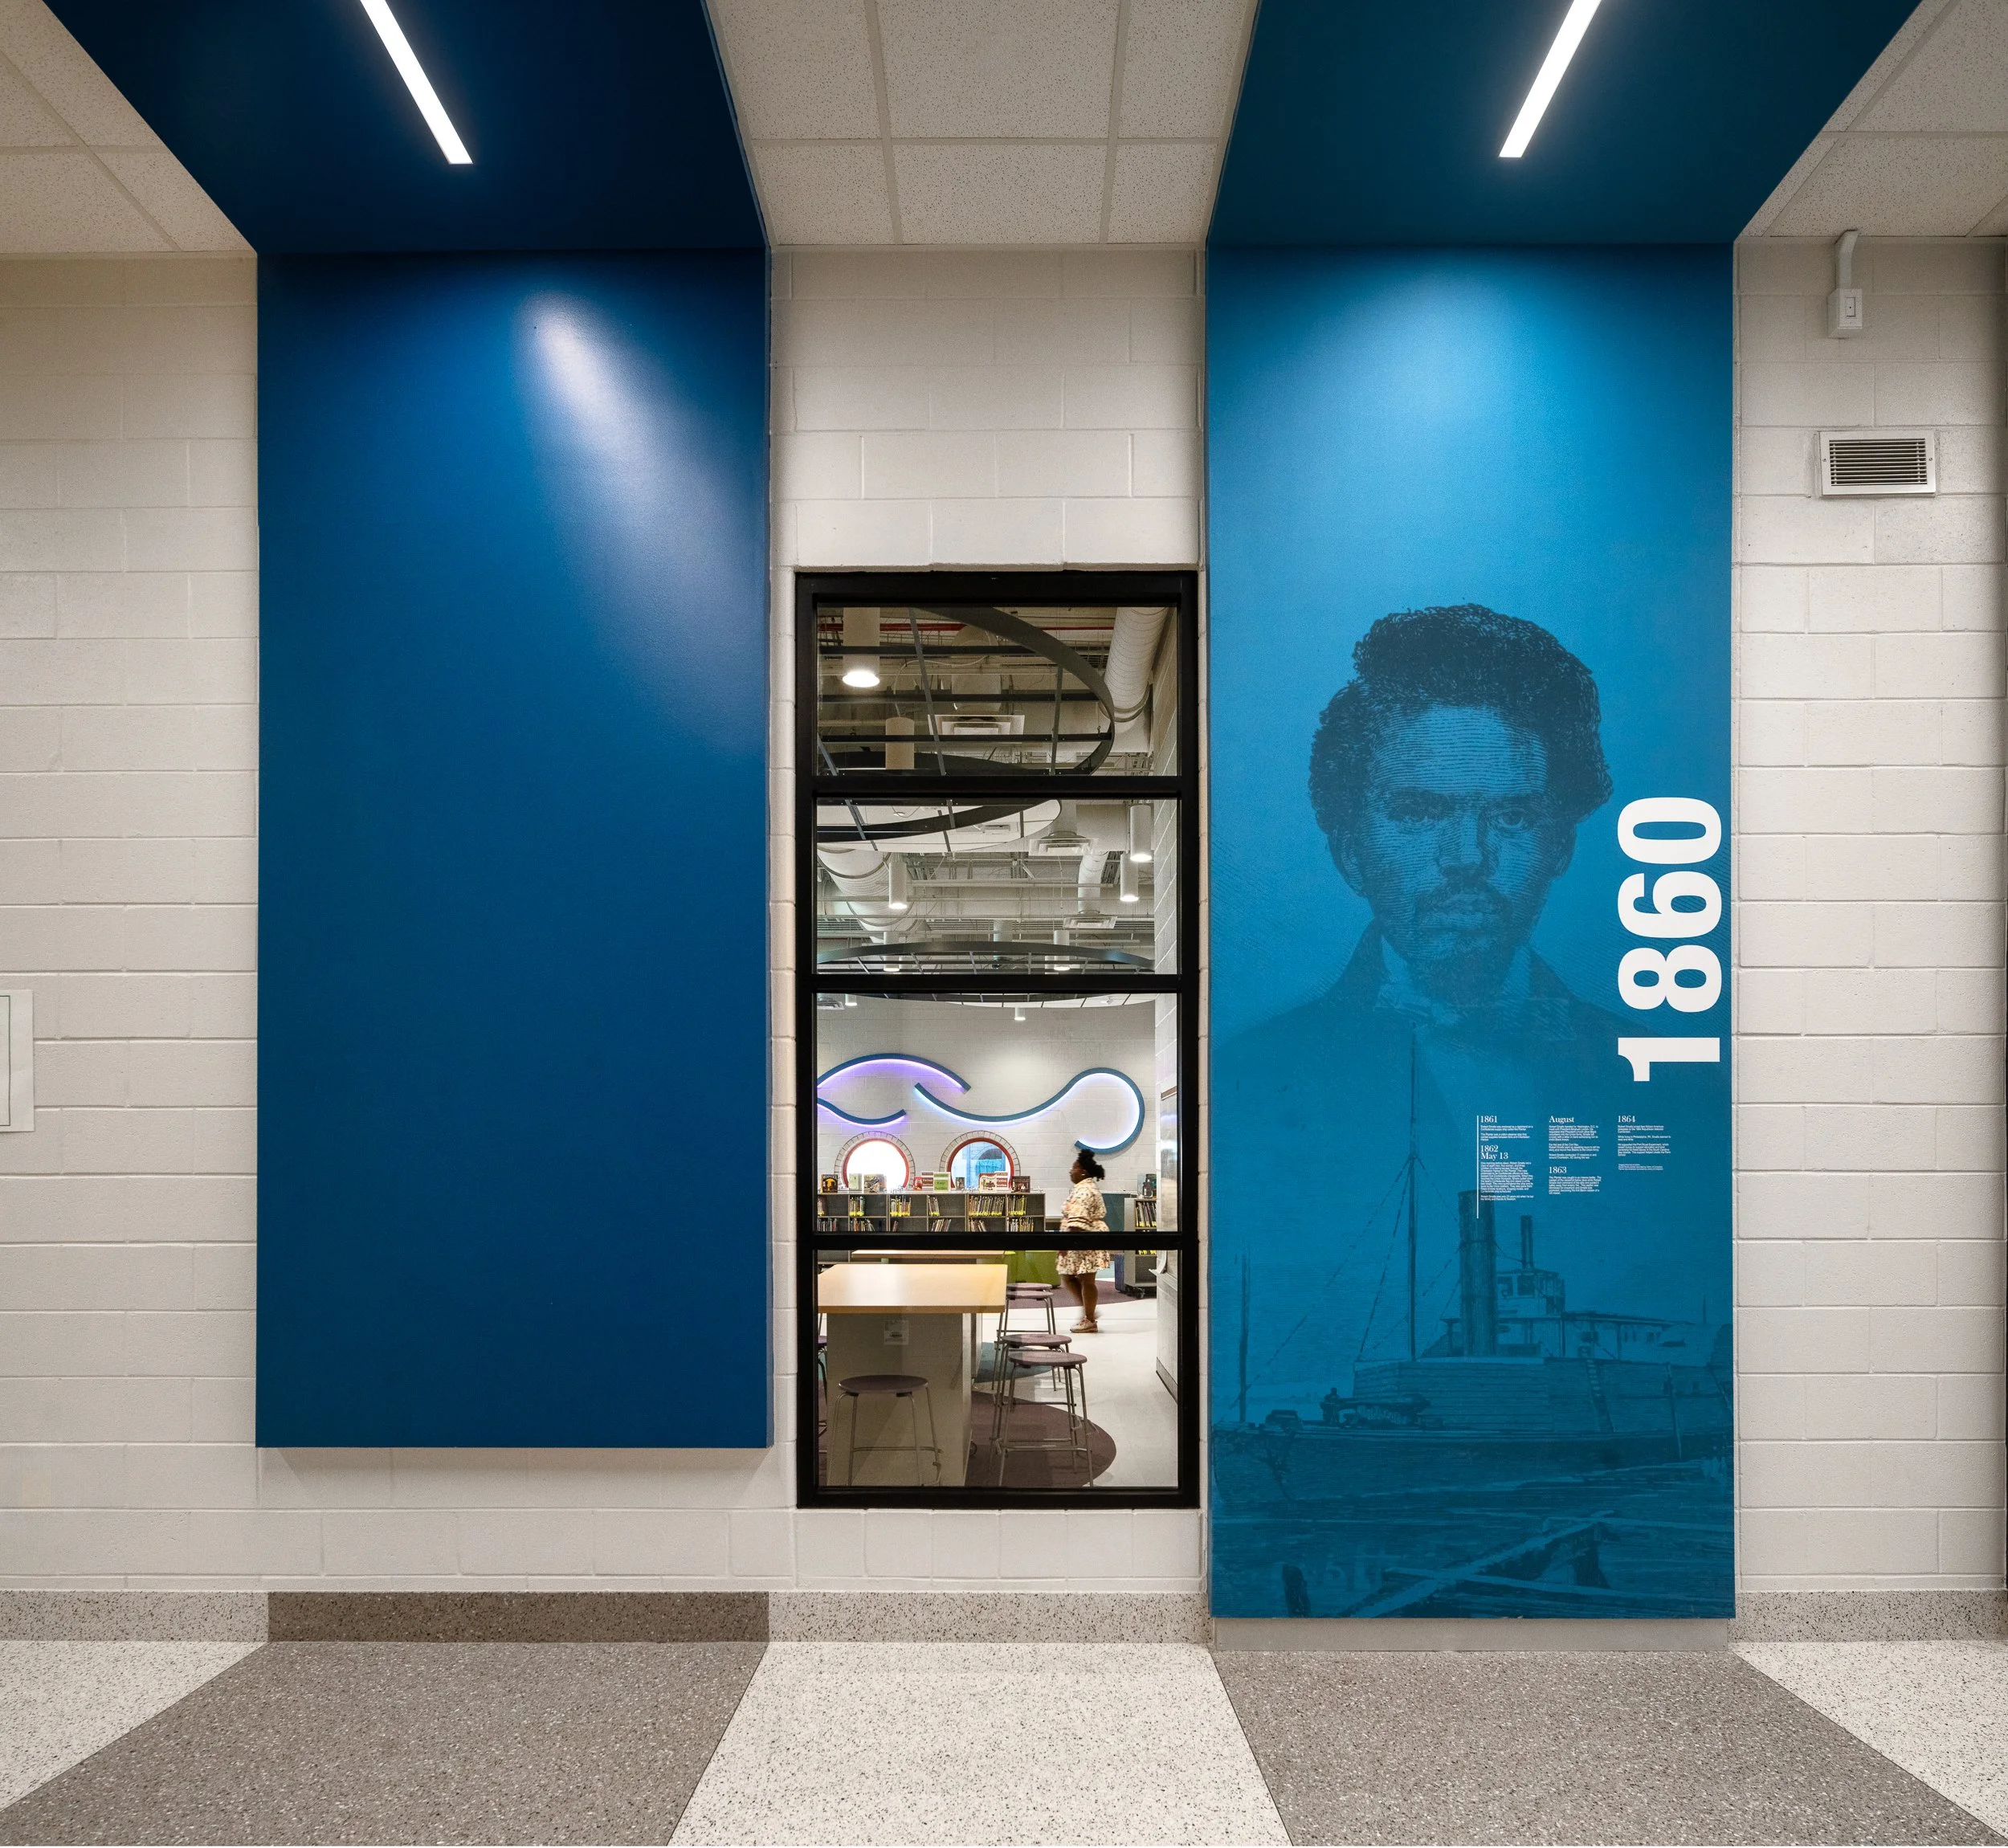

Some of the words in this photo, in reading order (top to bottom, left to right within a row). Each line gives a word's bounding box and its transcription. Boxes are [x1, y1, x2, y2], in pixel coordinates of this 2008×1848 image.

[1617, 797, 1722, 1082] 1860
[1480, 1115, 1498, 1124] 1861
[1549, 1115, 1574, 1124] August
[1618, 1115, 1636, 1123] 1864
[1480, 1144, 1499, 1152] 1862
[1480, 1152, 1497, 1161] May
[1500, 1152, 1509, 1160] 13
[1549, 1166, 1567, 1174] 1863
